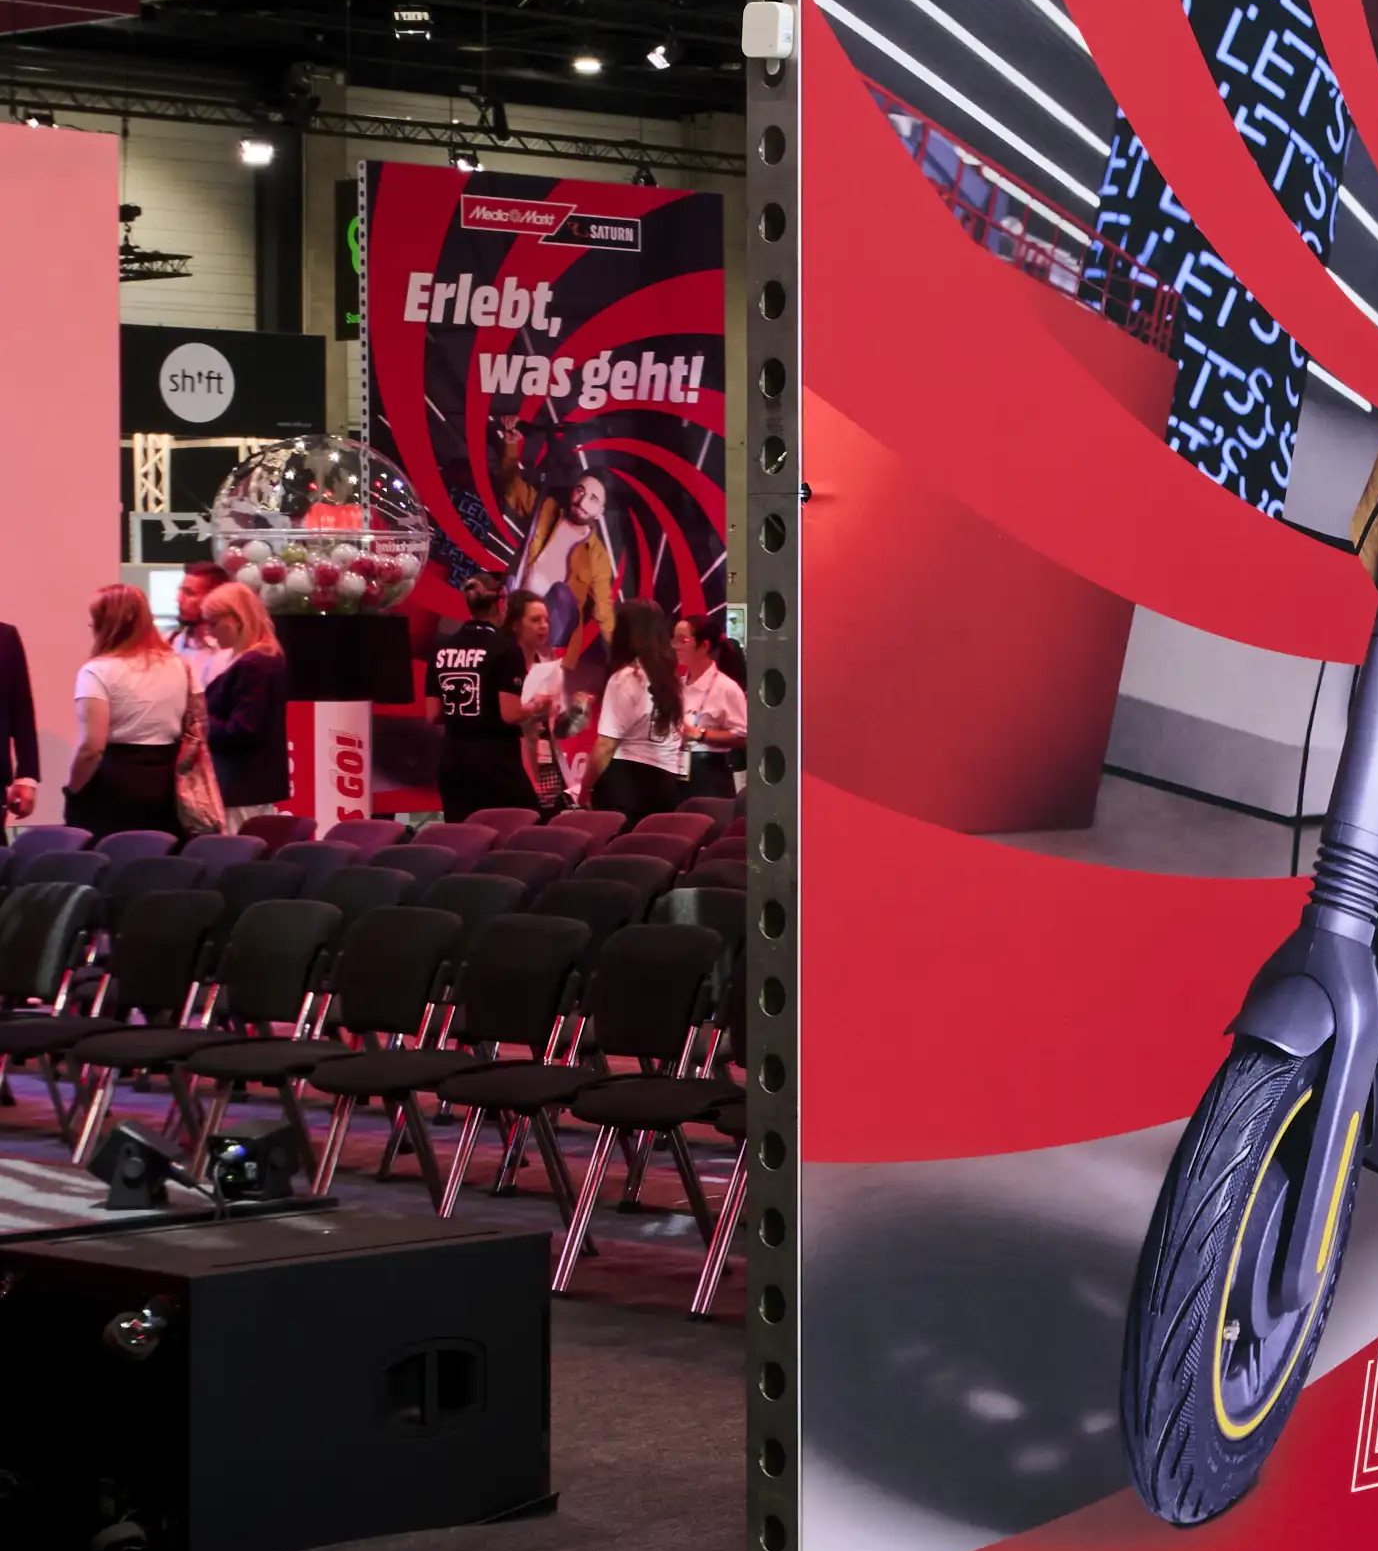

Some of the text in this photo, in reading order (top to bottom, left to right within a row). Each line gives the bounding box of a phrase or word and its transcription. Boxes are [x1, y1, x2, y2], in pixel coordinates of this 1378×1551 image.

[589, 223, 635, 242] SATURN
[403, 270, 562, 338] Erlebt,
[478, 349, 705, 410] was geht!
[435, 646, 487, 672] STAFF
[335, 735, 364, 799] GO!
